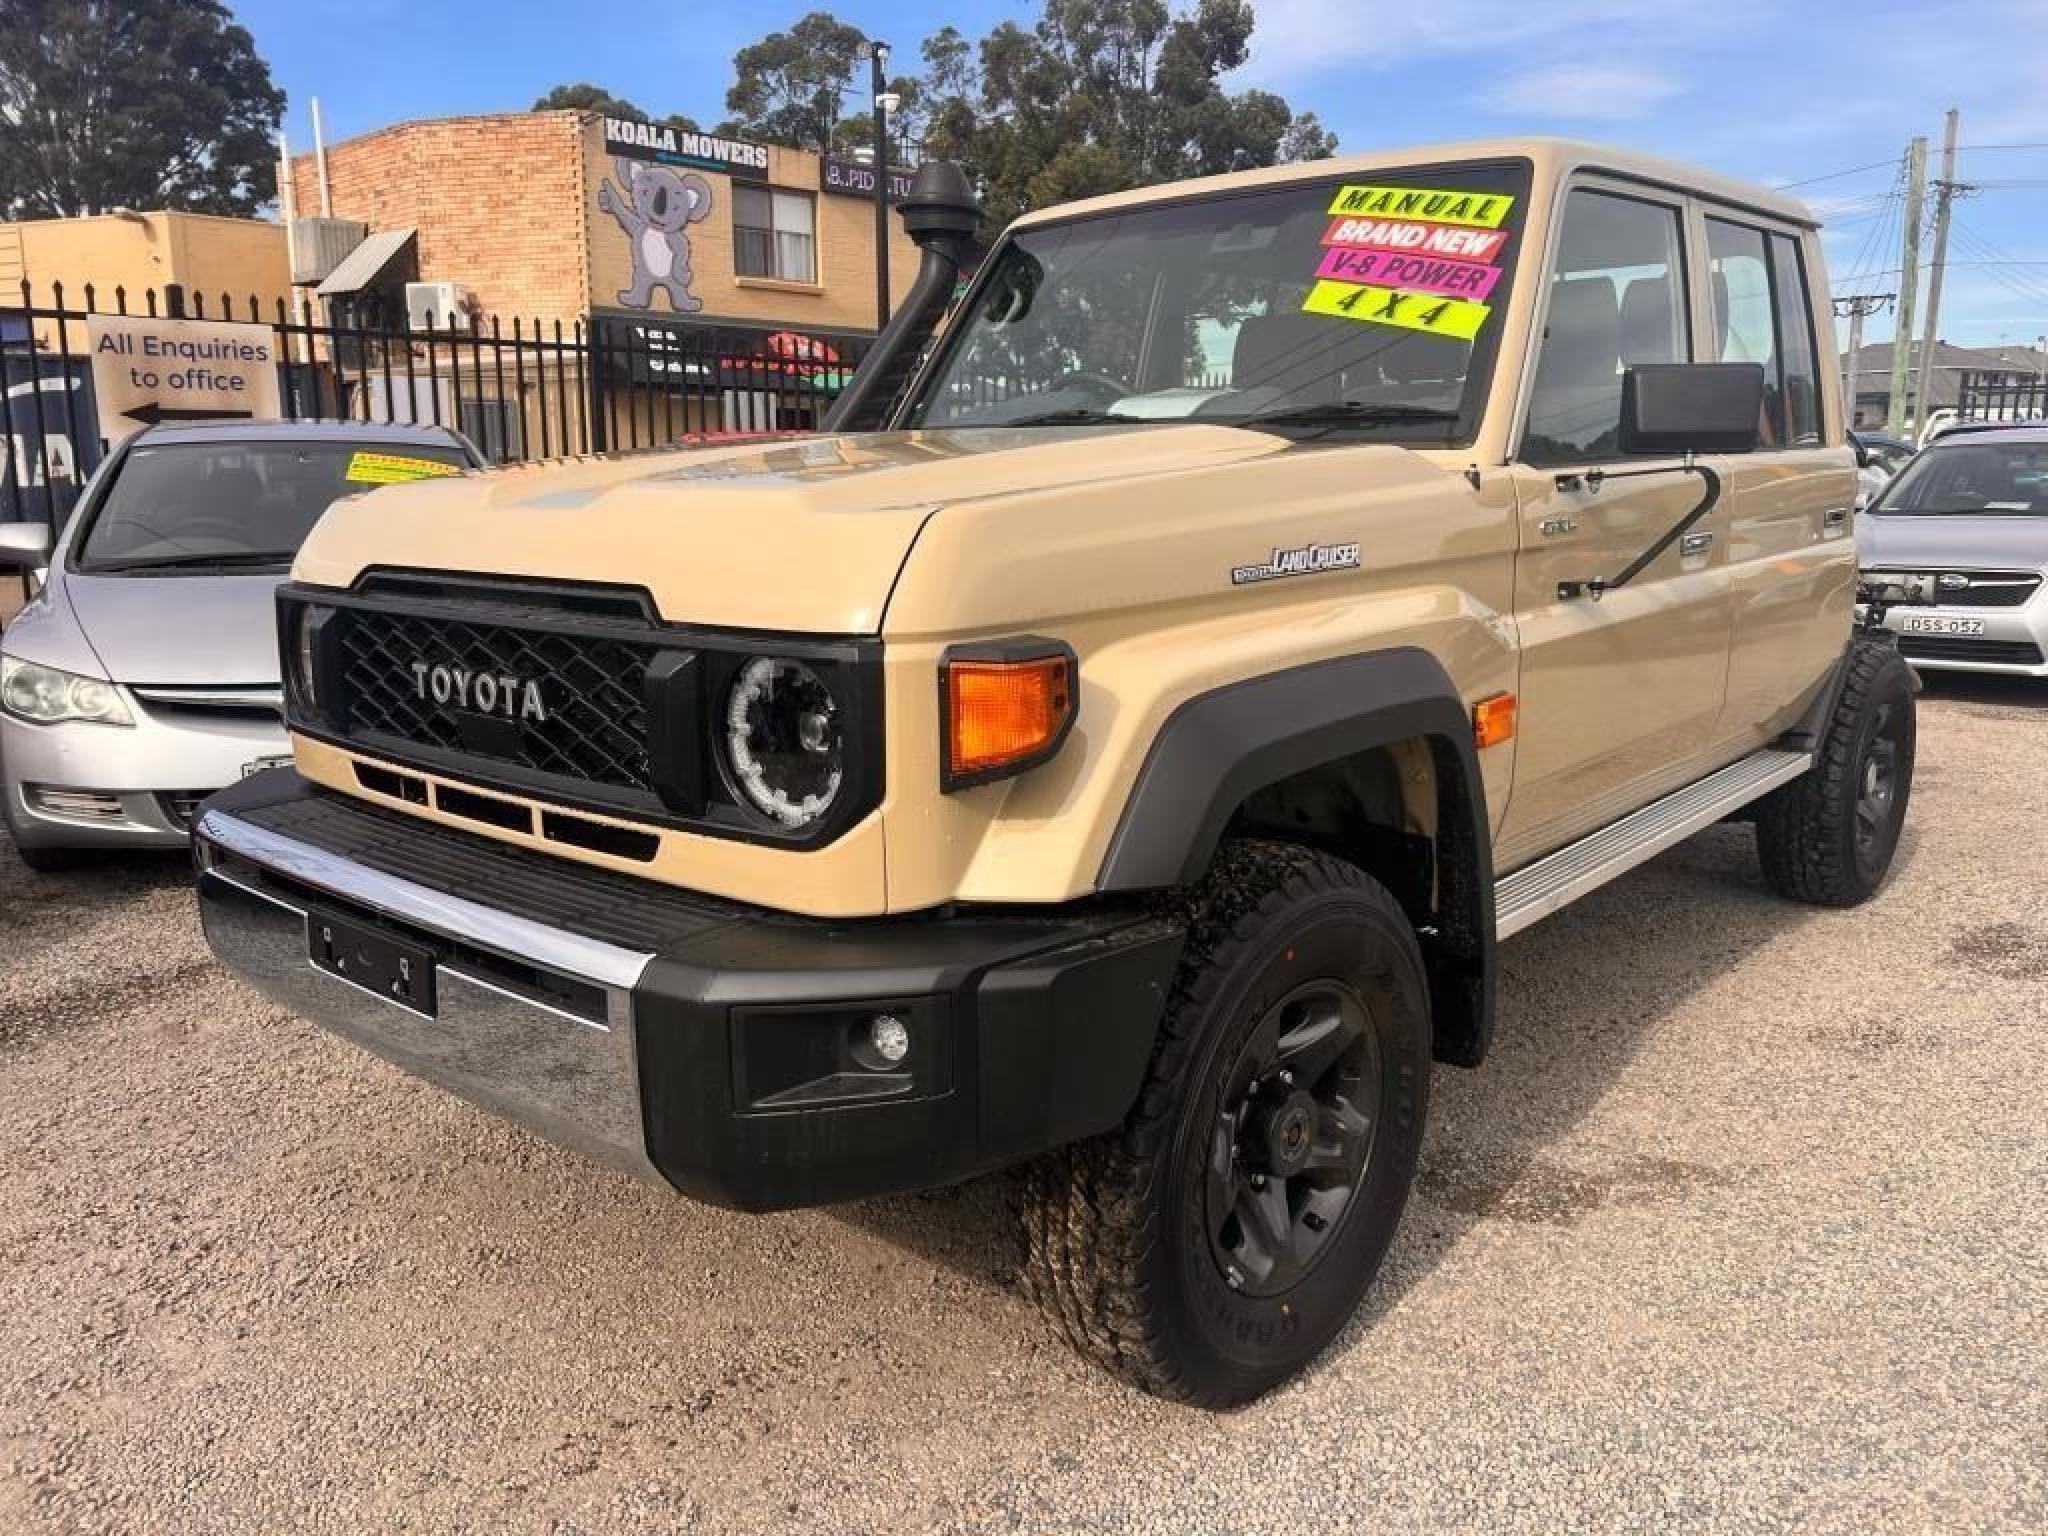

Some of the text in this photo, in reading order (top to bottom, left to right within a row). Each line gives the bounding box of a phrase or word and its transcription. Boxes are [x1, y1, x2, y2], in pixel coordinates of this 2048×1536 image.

[605, 117, 677, 151] KOALA
[682, 132, 767, 168] MOWERS
[1340, 189, 1498, 220] MANUAL
[1332, 219, 1499, 257] BRAND NEW
[1331, 251, 1488, 291] V-8 POWER
[1336, 287, 1451, 325] 4 X 4
[97, 332, 269, 362] All Enquiries
[130, 367, 245, 391] to office
[411, 663, 545, 721] TOYOTA
